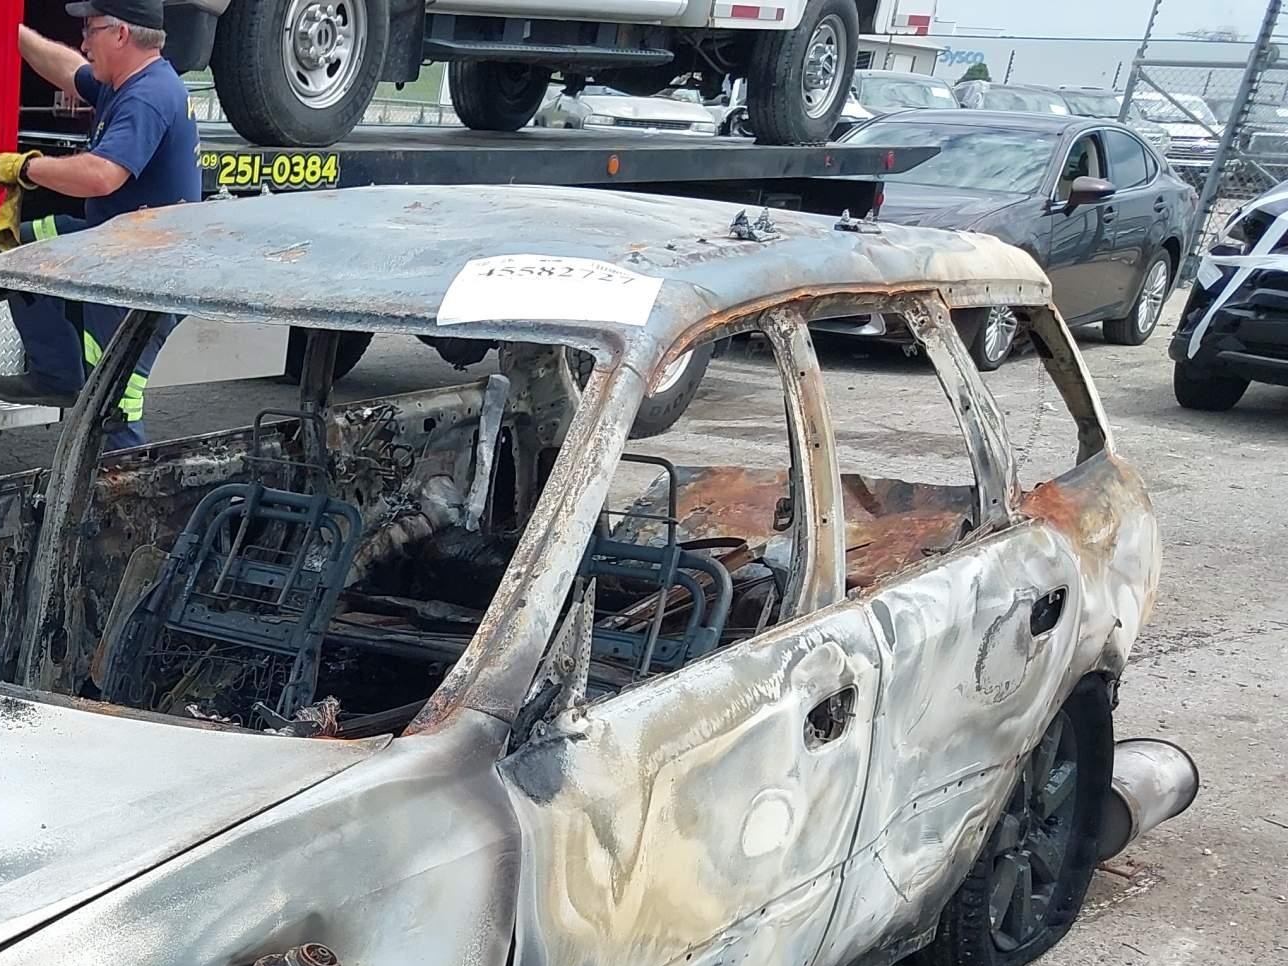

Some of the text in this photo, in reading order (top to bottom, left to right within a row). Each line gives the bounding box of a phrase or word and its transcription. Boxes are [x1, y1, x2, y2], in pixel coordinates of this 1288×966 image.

[200, 153, 218, 167] 09
[219, 154, 338, 184] 251-0384
[477, 265, 635, 285] 45582727
